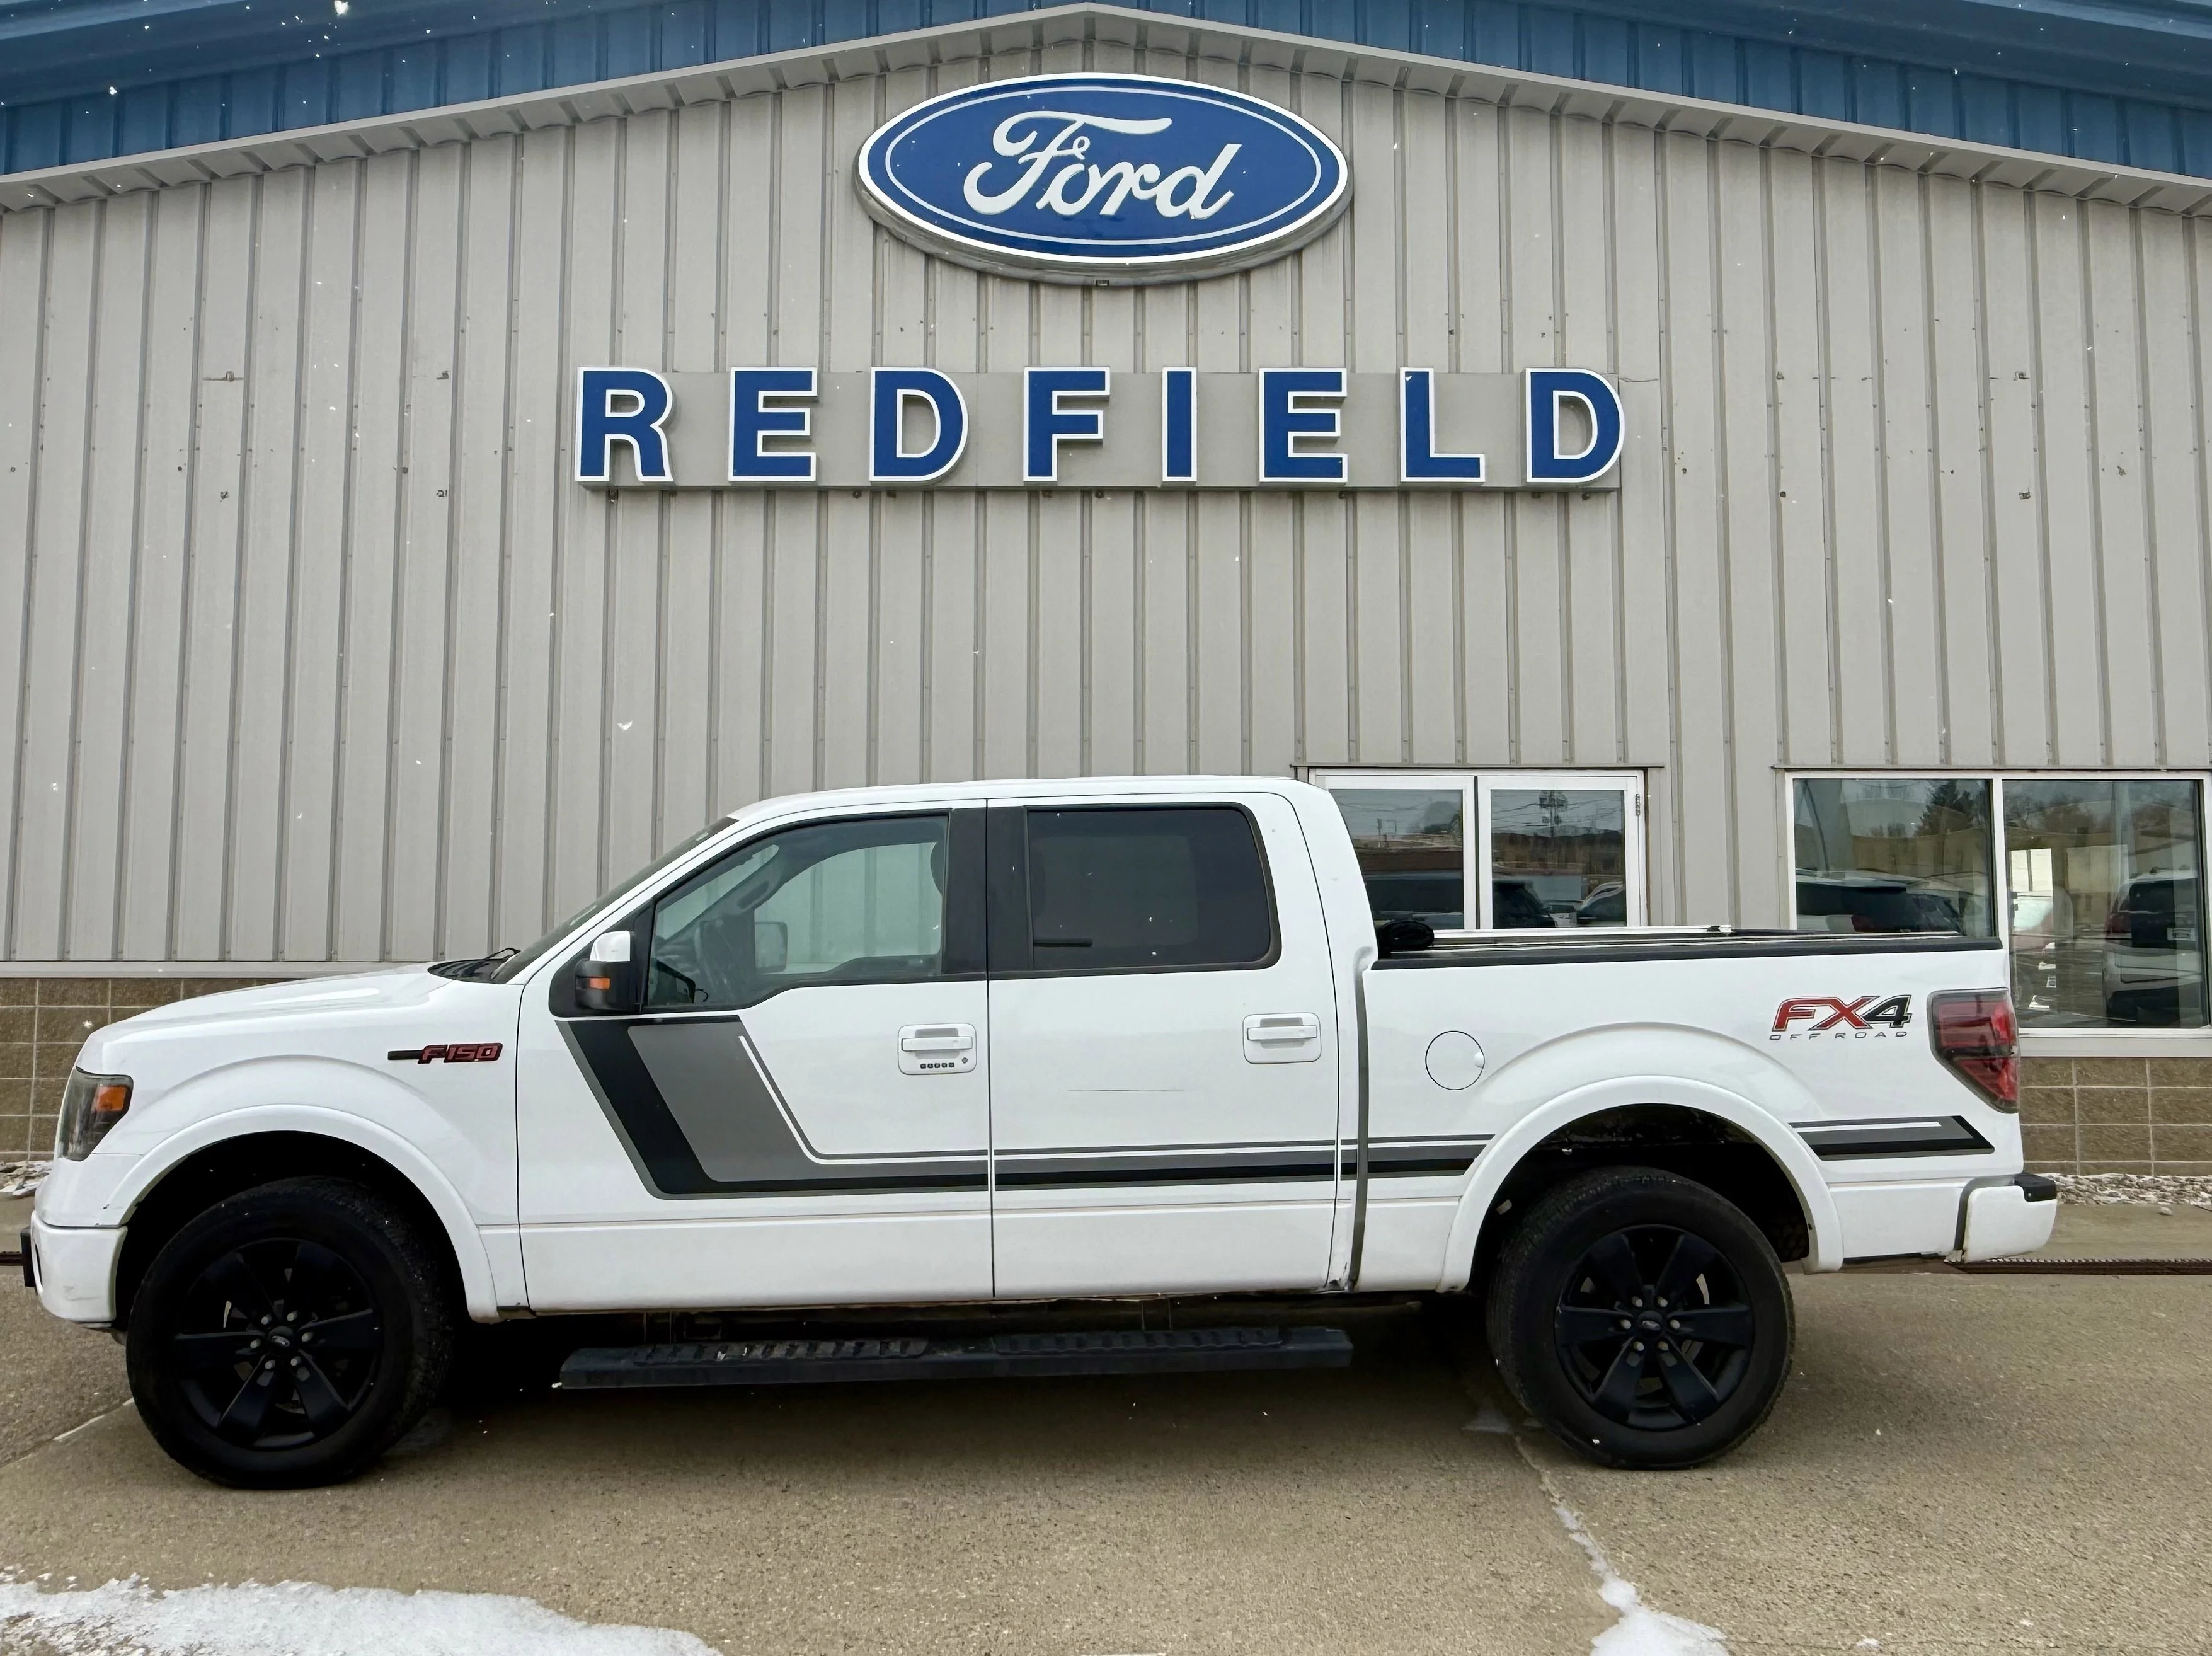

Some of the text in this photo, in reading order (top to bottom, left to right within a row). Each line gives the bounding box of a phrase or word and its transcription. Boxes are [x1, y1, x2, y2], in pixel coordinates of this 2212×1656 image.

[963, 110, 1242, 220] Ford
[573, 365, 1626, 483] REDFIELD
[1772, 994, 1913, 1032] FX4
[418, 1042, 503, 1064] F150
[1834, 1030, 1908, 1039] ROAD
